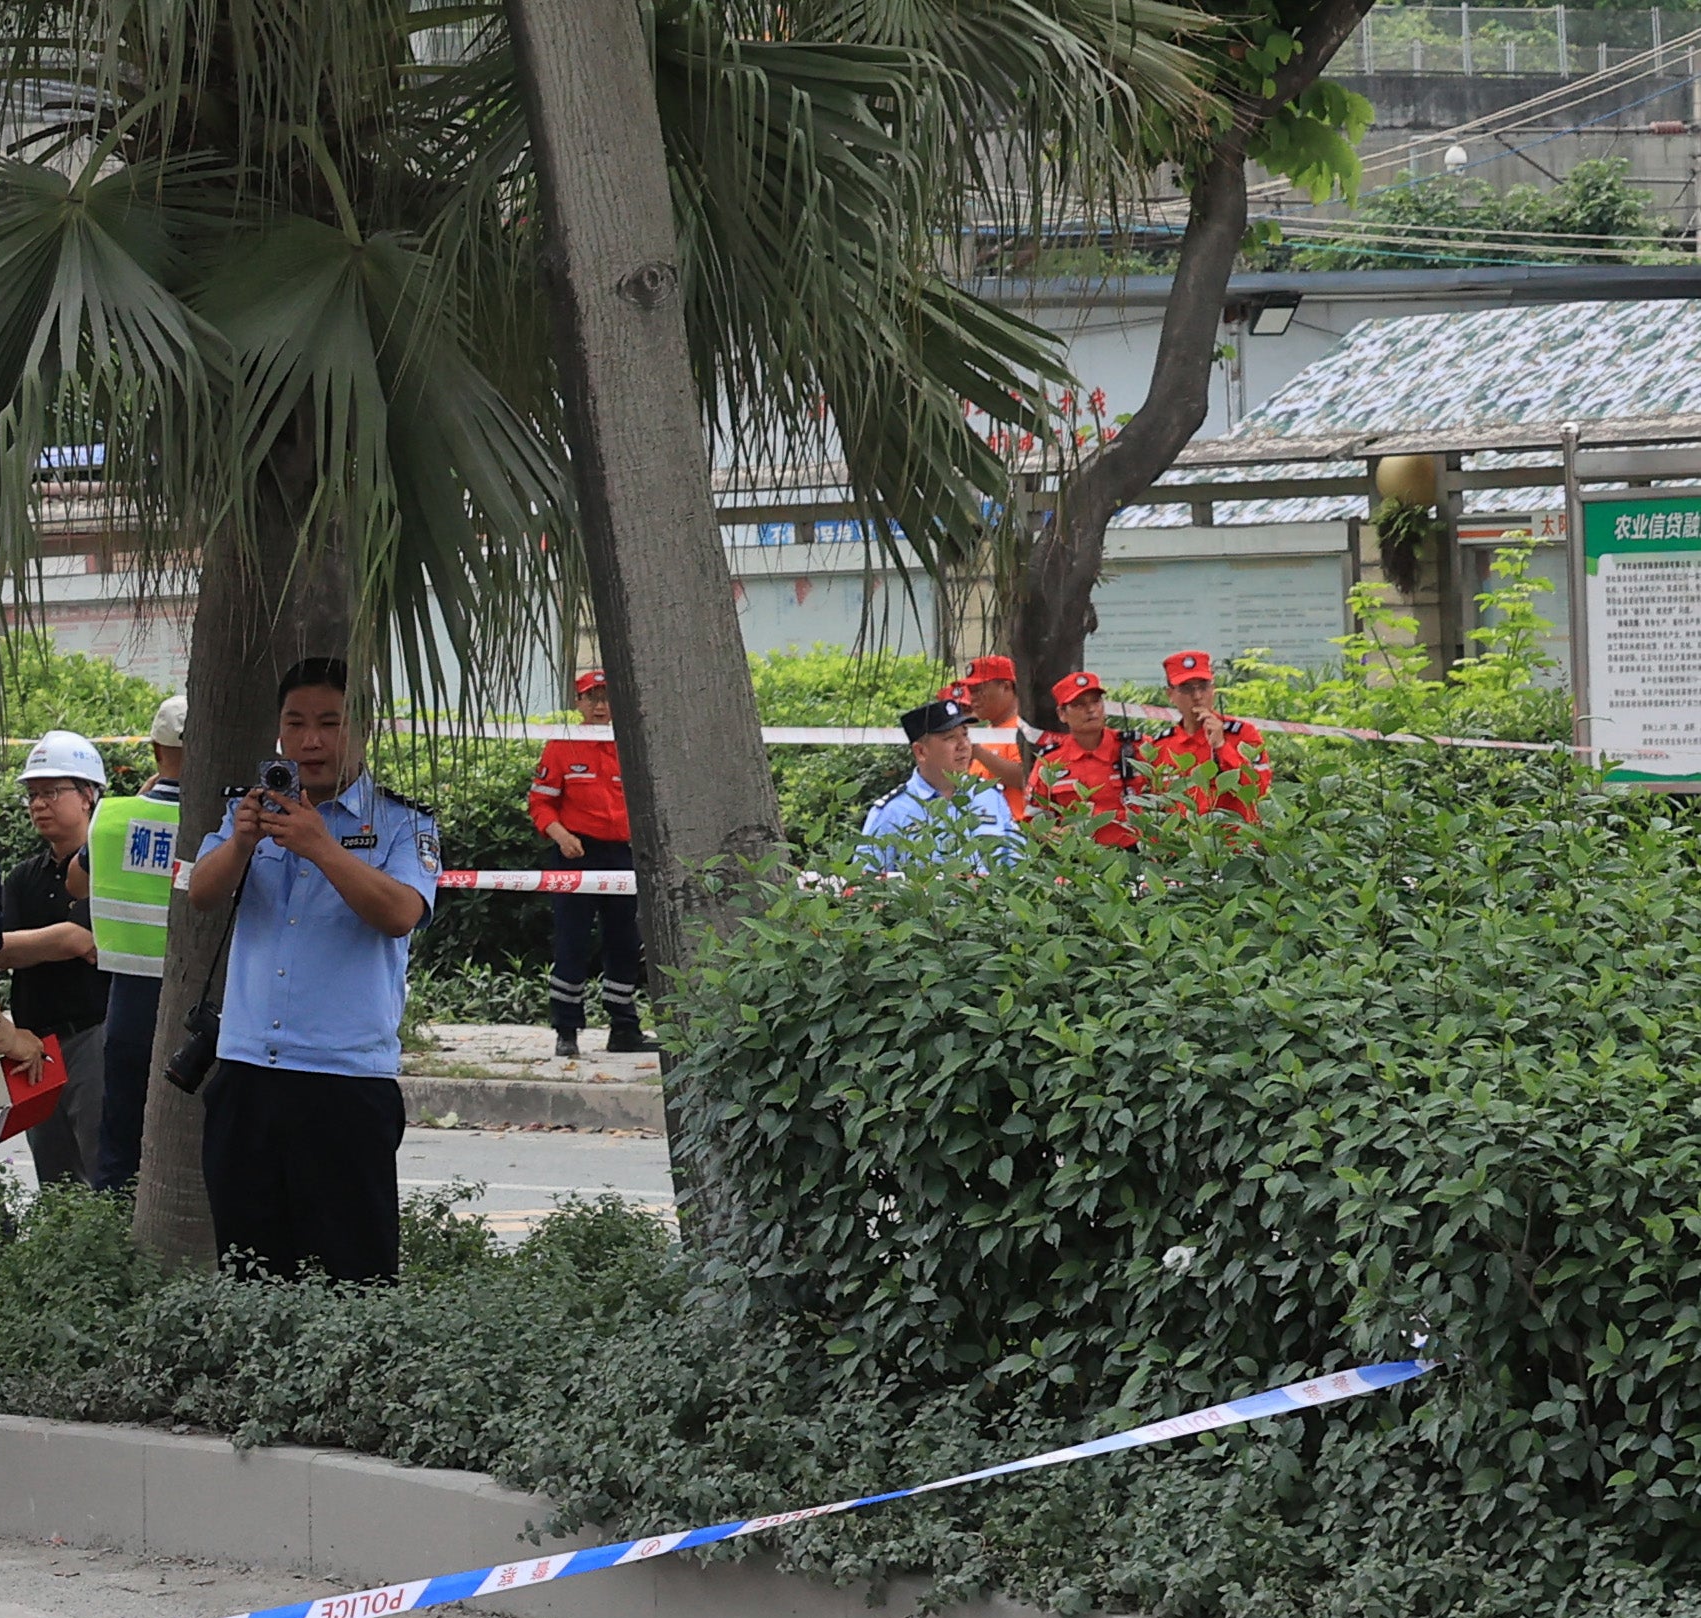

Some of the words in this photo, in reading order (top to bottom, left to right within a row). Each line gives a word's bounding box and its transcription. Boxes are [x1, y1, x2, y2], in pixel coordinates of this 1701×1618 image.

[1614, 511, 1701, 540] 农业信贷融
[130, 825, 174, 869] 柳南
